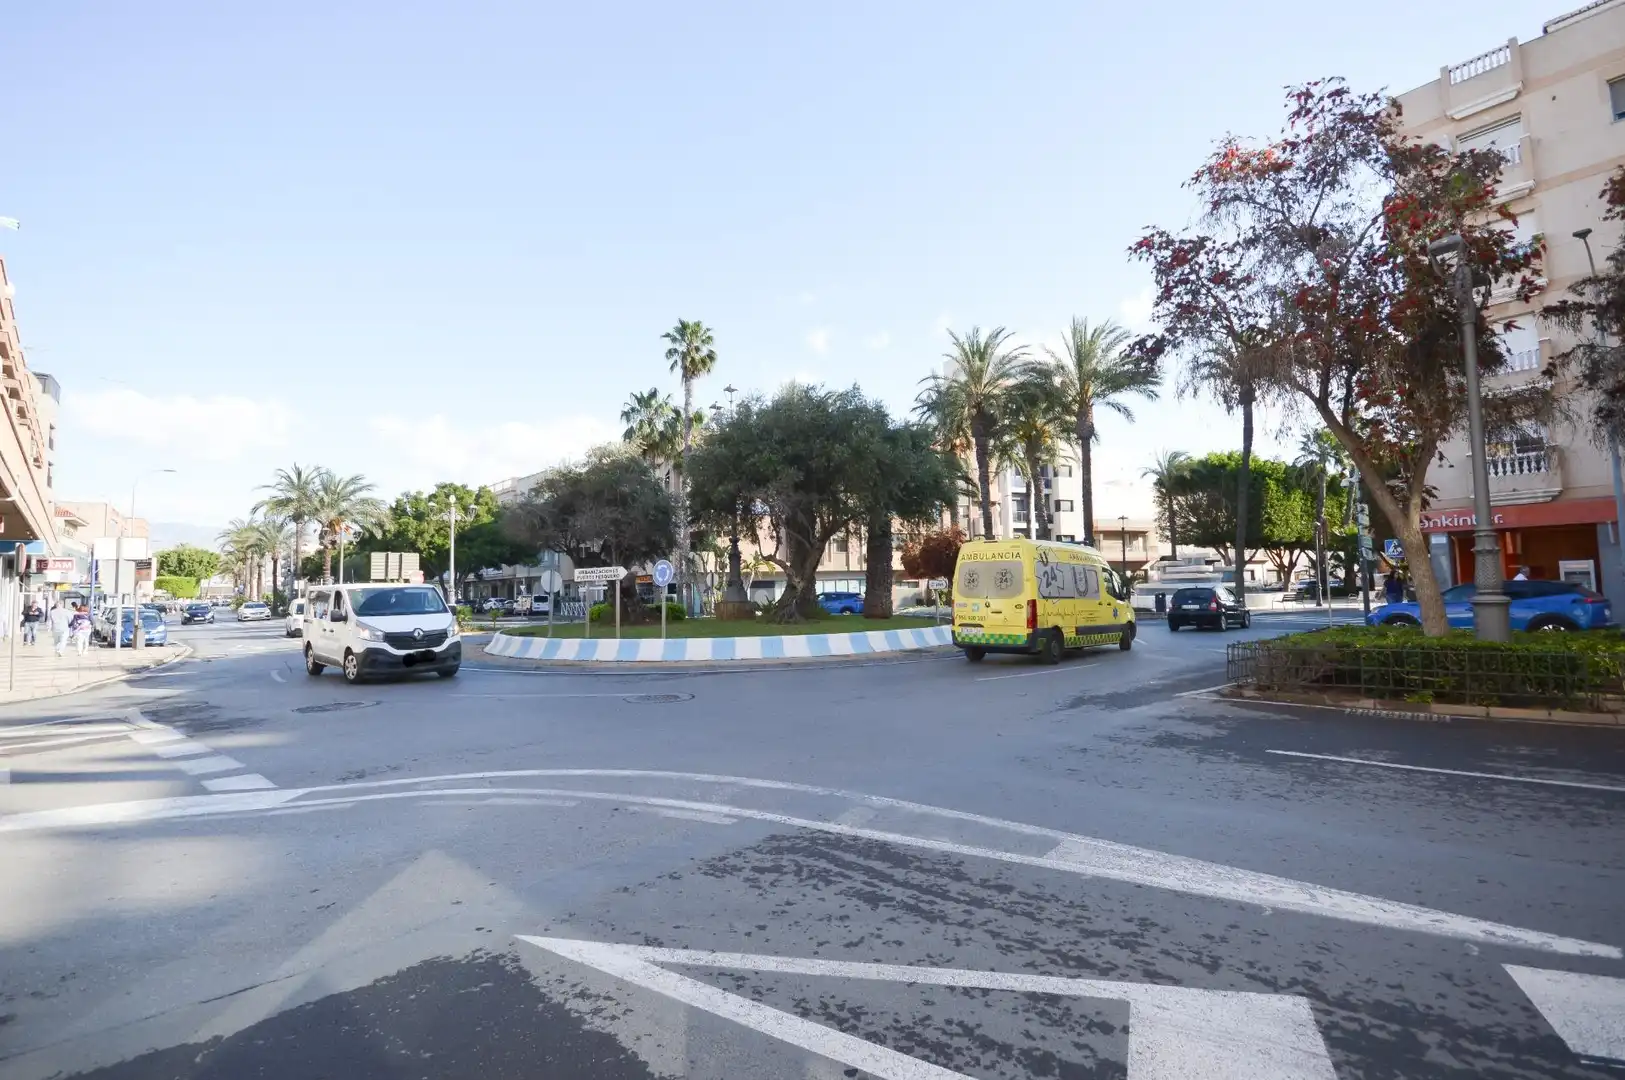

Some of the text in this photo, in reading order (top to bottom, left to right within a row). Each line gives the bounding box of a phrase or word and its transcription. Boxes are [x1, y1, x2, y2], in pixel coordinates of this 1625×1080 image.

[1420, 514, 1504, 528] ankintr.
[960, 552, 1021, 560] AMBULANCIA
[1043, 566, 1058, 588] 24
